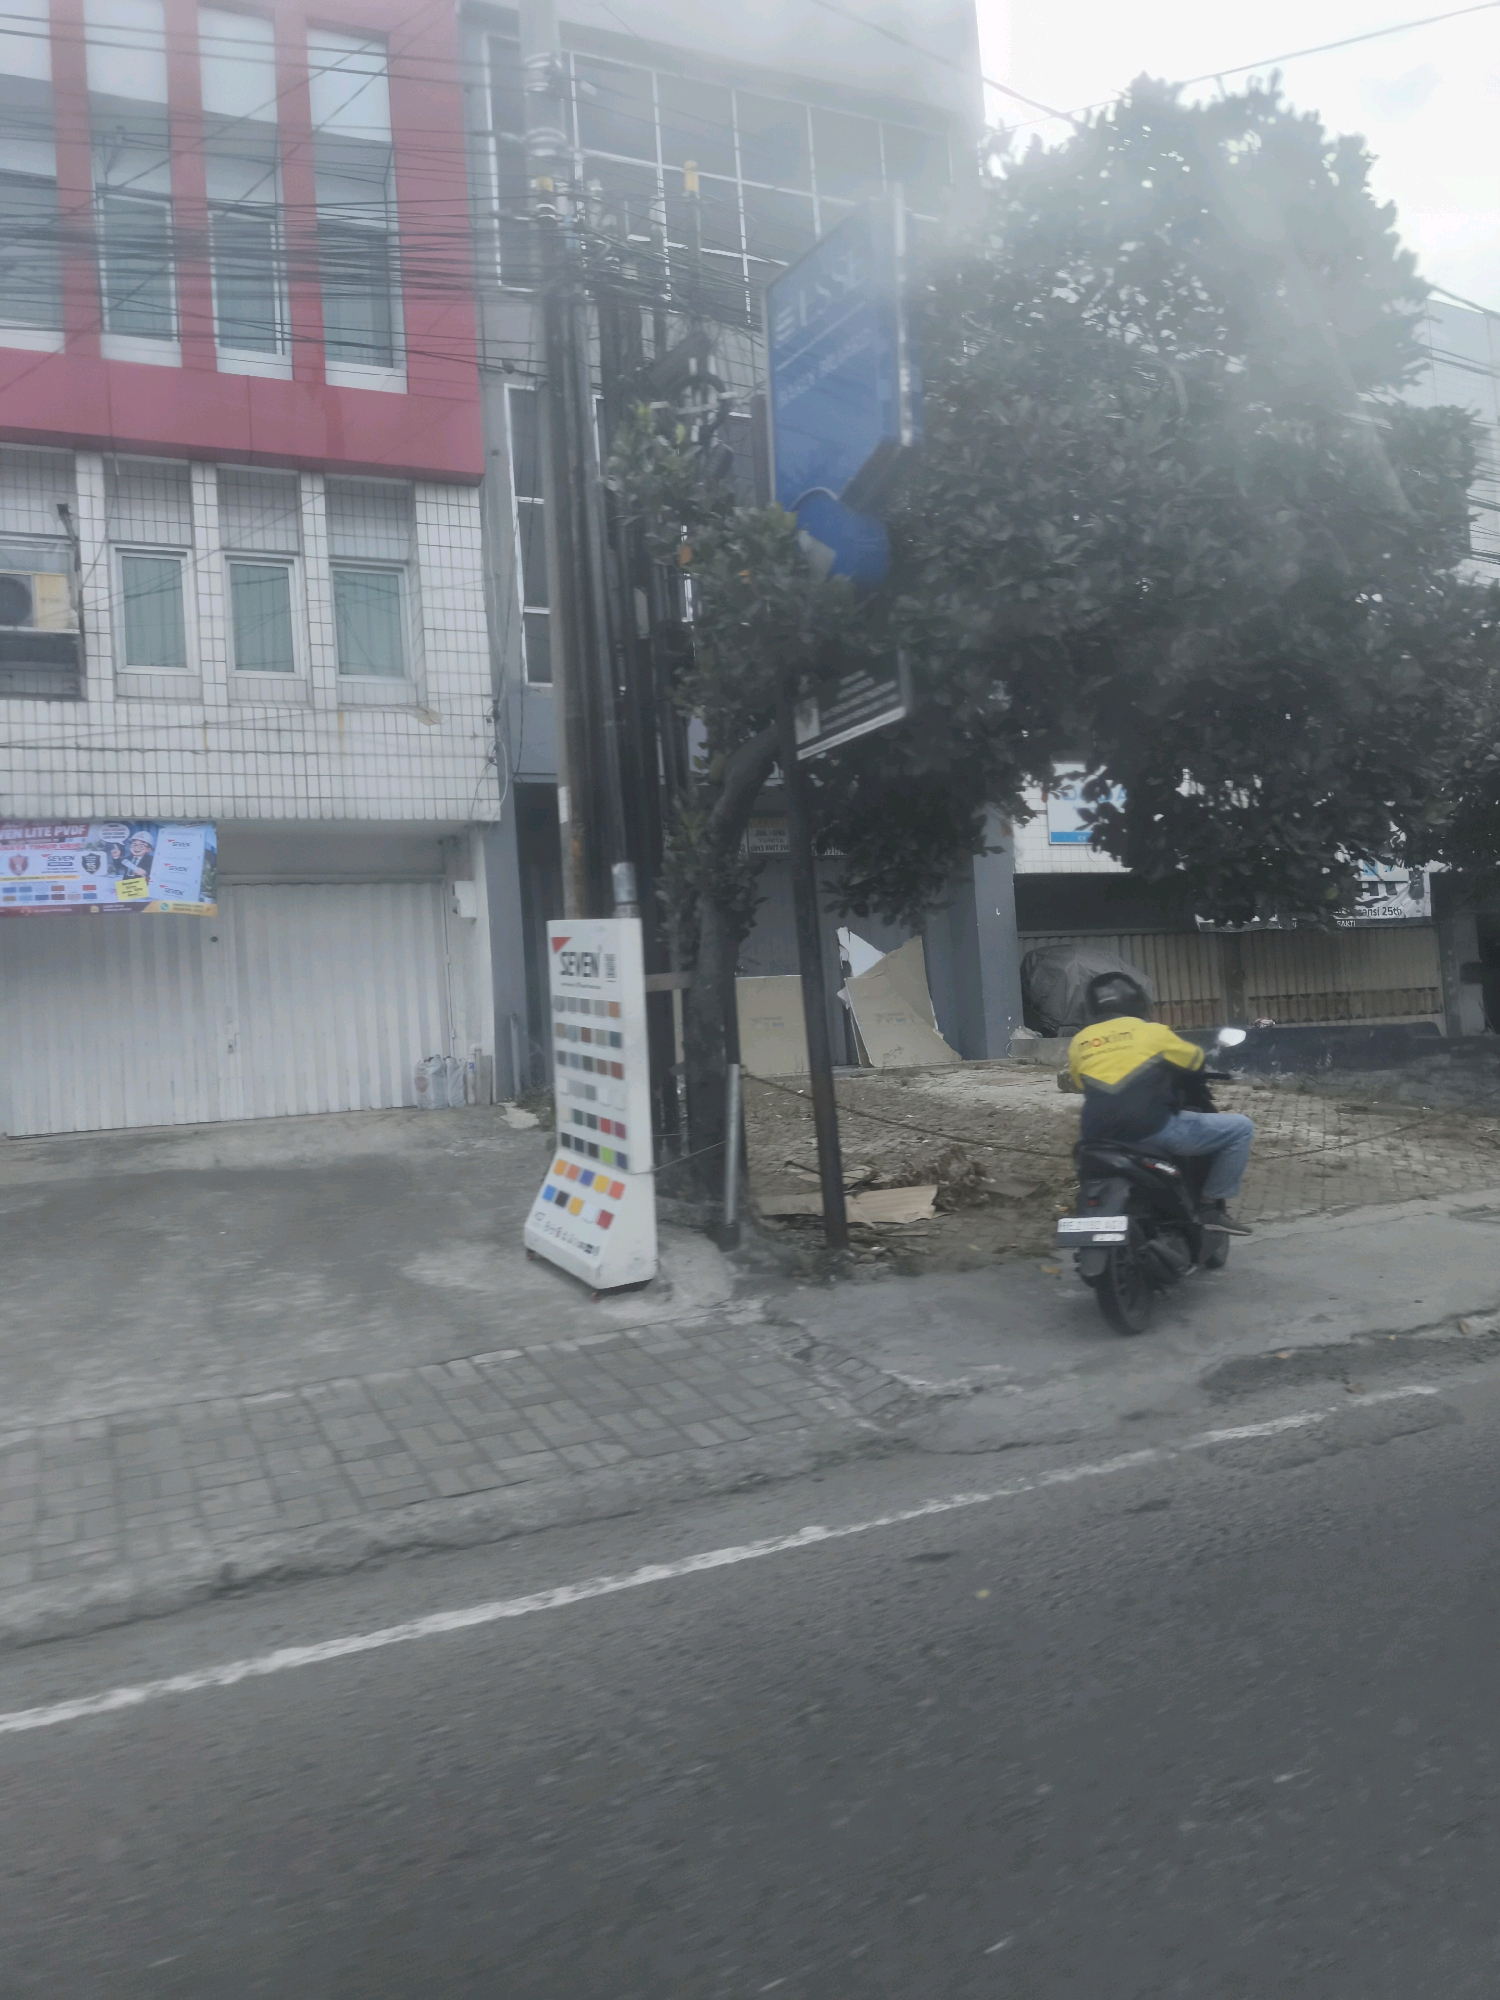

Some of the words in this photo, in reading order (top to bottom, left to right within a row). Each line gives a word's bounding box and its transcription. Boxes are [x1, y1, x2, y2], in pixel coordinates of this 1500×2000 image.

[25, 827, 52, 838] LITE
[54, 825, 86, 836] PVDF
[1382, 906, 1402, 916] 25th
[559, 951, 601, 978] SEVEN
